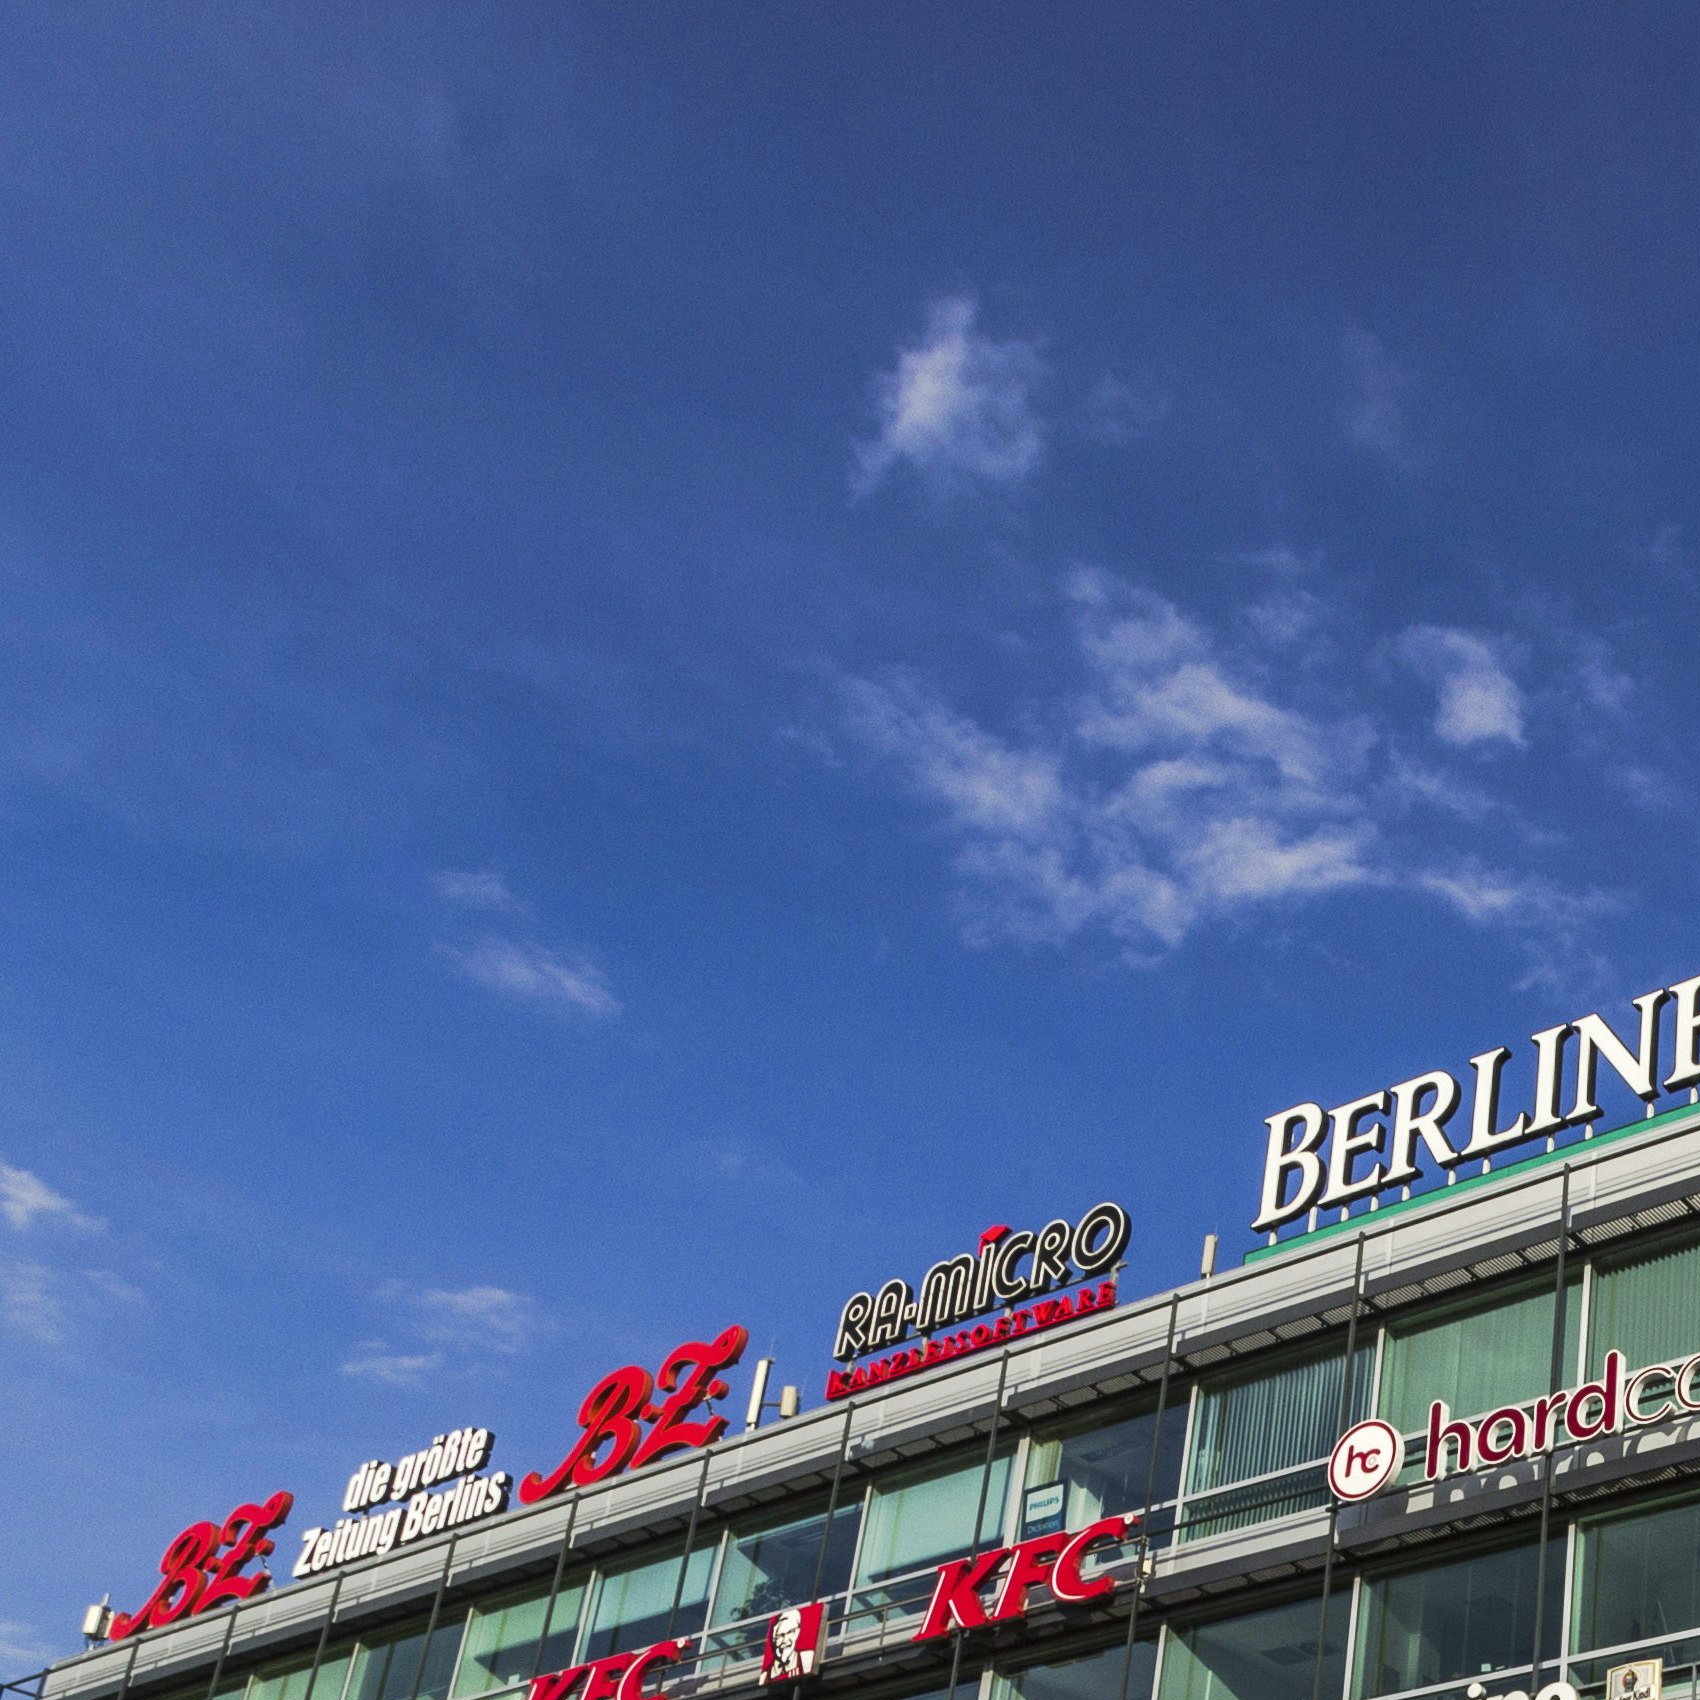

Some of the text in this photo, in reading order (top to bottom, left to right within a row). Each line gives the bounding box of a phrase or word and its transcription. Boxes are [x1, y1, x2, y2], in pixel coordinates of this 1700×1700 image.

[826, 1281, 1117, 1400] KANZLEISOFTWARE
[292, 1471, 508, 1577] Zeitung Berlins
[343, 1427, 490, 1512] die größte
[913, 1514, 1141, 1642] KFC
